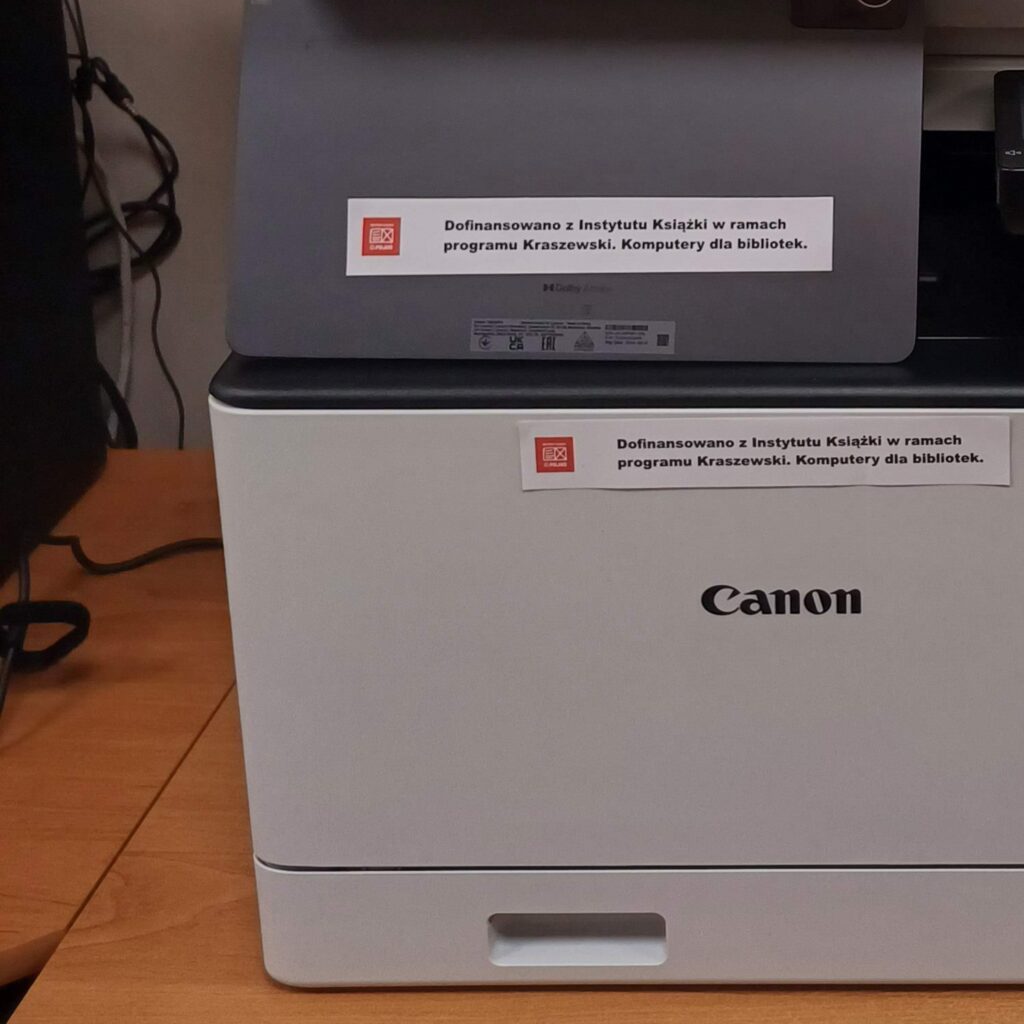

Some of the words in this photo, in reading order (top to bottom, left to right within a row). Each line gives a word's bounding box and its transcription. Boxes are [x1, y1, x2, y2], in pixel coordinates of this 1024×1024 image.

[444, 219, 562, 232] Dofinansowano
[565, 221, 574, 231] z
[578, 219, 648, 234] Instytutu
[652, 218, 708, 233] Książki
[712, 221, 726, 230] w
[730, 218, 787, 230] ramach
[443, 241, 518, 254] programu
[522, 238, 617, 251] Kraszewski.
[621, 238, 705, 253] Komputery
[709, 237, 733, 250] dla
[737, 237, 808, 250] bibliotek.
[616, 438, 735, 450] Dofinansowano
[738, 439, 748, 449] z
[752, 436, 822, 451] Instytutu
[826, 435, 882, 450] Książki
[886, 437, 901, 447] w
[904, 434, 962, 447] ramach
[617, 458, 692, 472] programu
[697, 454, 791, 467] Kraszewski.
[795, 454, 880, 468] Komputery
[884, 453, 908, 465] dla
[912, 452, 984, 464] bibliotek.
[700, 584, 862, 616] Canon
